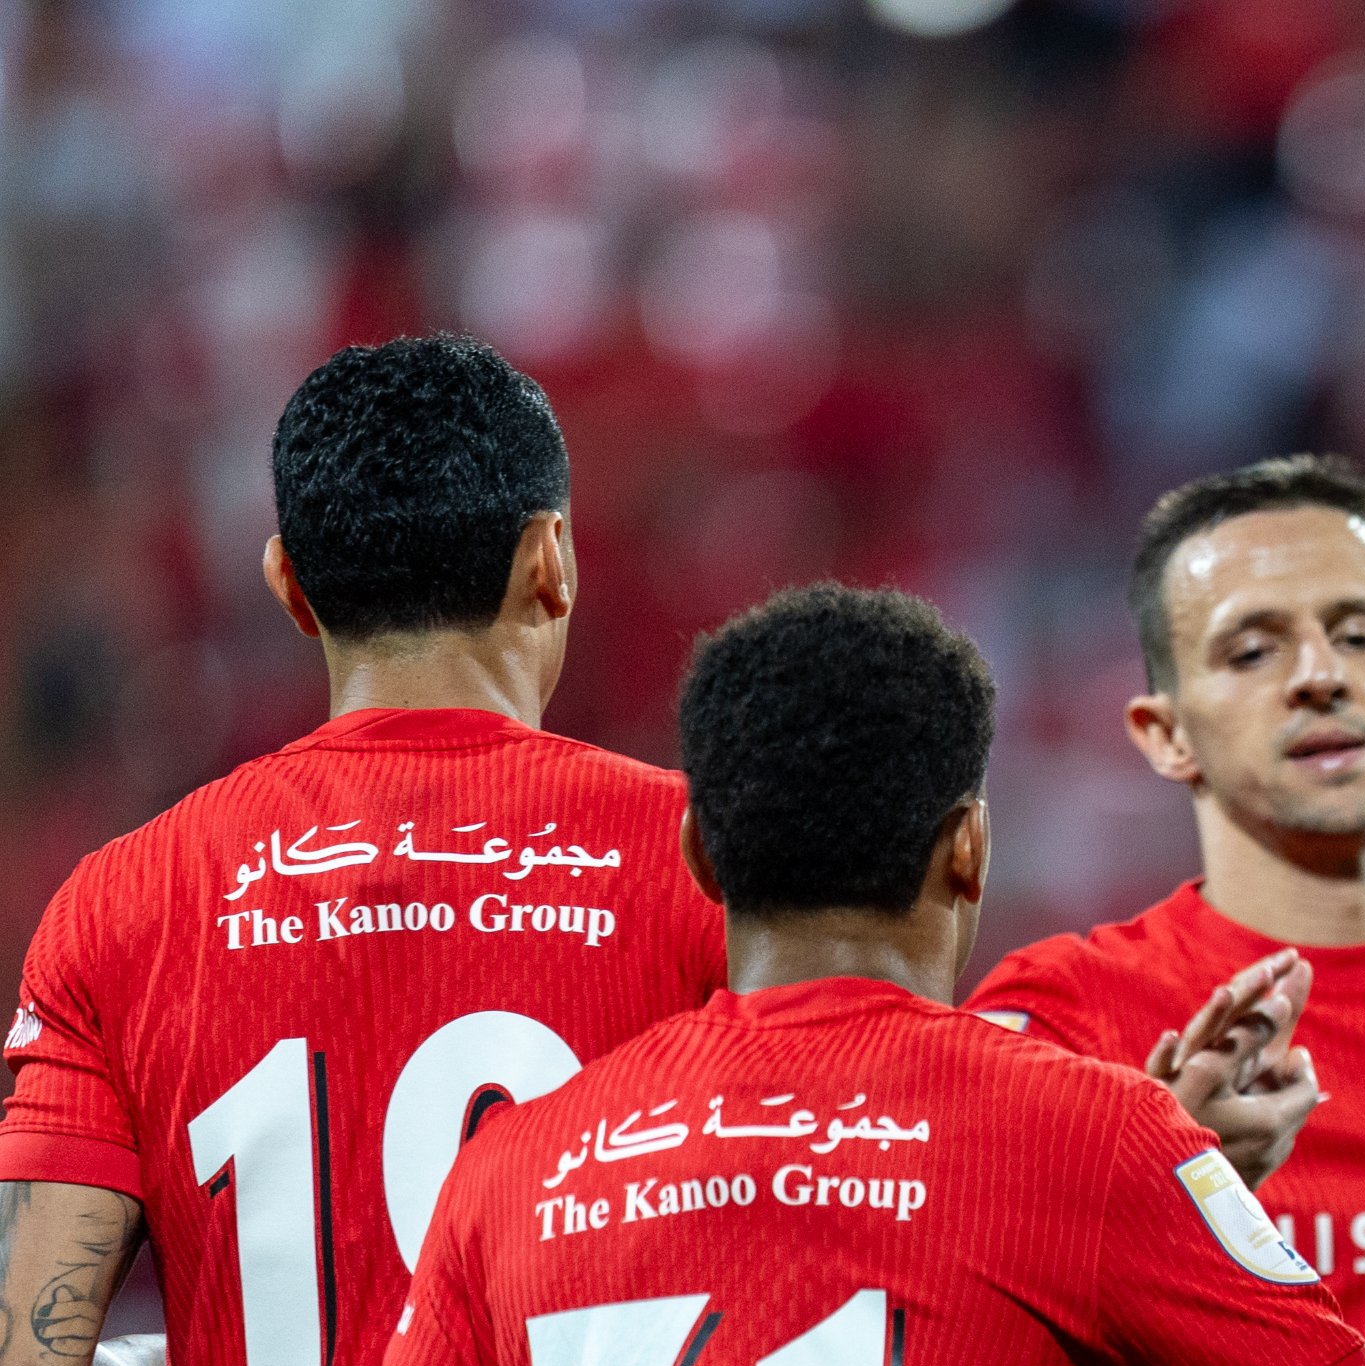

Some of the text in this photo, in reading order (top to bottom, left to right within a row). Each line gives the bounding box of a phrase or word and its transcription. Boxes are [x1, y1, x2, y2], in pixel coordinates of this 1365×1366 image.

[217, 893, 616, 950] The Kanoo Group
[534, 1164, 927, 1242] The Kanoo Group
